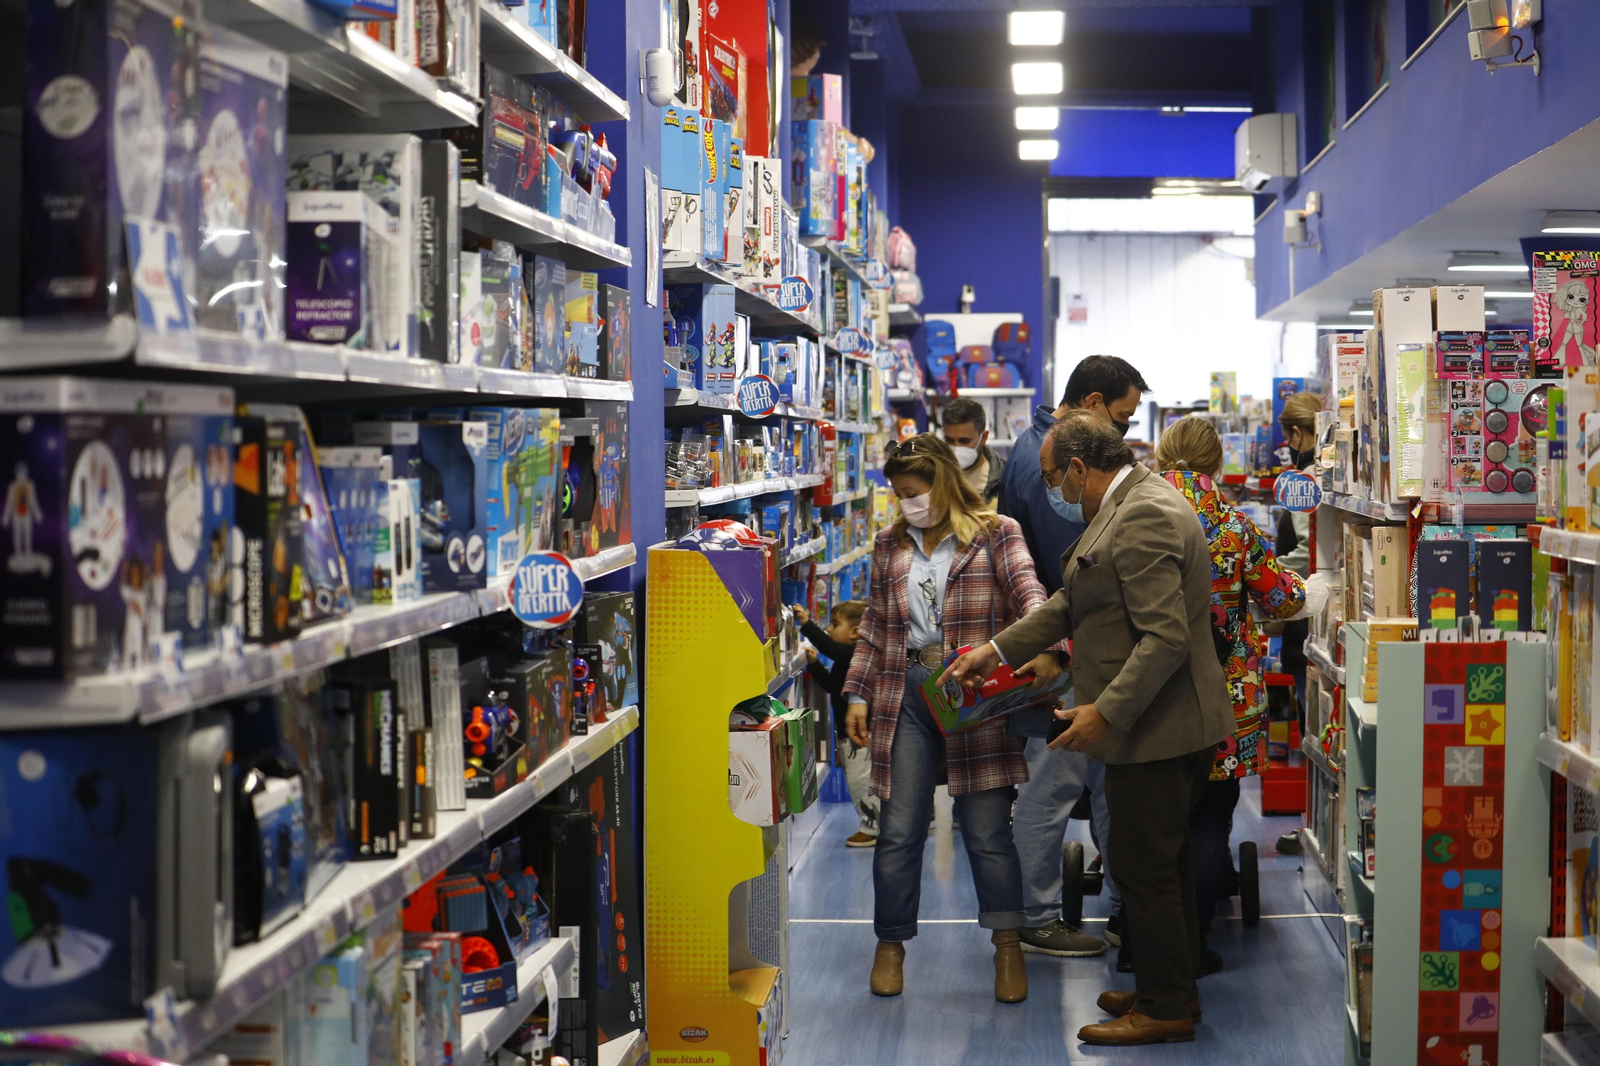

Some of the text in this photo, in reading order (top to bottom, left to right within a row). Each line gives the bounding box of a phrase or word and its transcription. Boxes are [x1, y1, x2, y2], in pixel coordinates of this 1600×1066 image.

[1573, 260, 1597, 270] OMG
[779, 279, 806, 297] SÚPER
[780, 292, 807, 308] OFERTTA
[741, 380, 771, 400] SÚPER
[743, 396, 774, 412] OFERTTA
[1287, 477, 1315, 497] SÚPER
[1286, 495, 1315, 507] OFERTTA
[517, 559, 570, 595] SÚPER
[518, 591, 572, 615] OFERTTA
[681, 1029, 707, 1038] BIZAK
[656, 1056, 715, 1064] www.bizak.es
